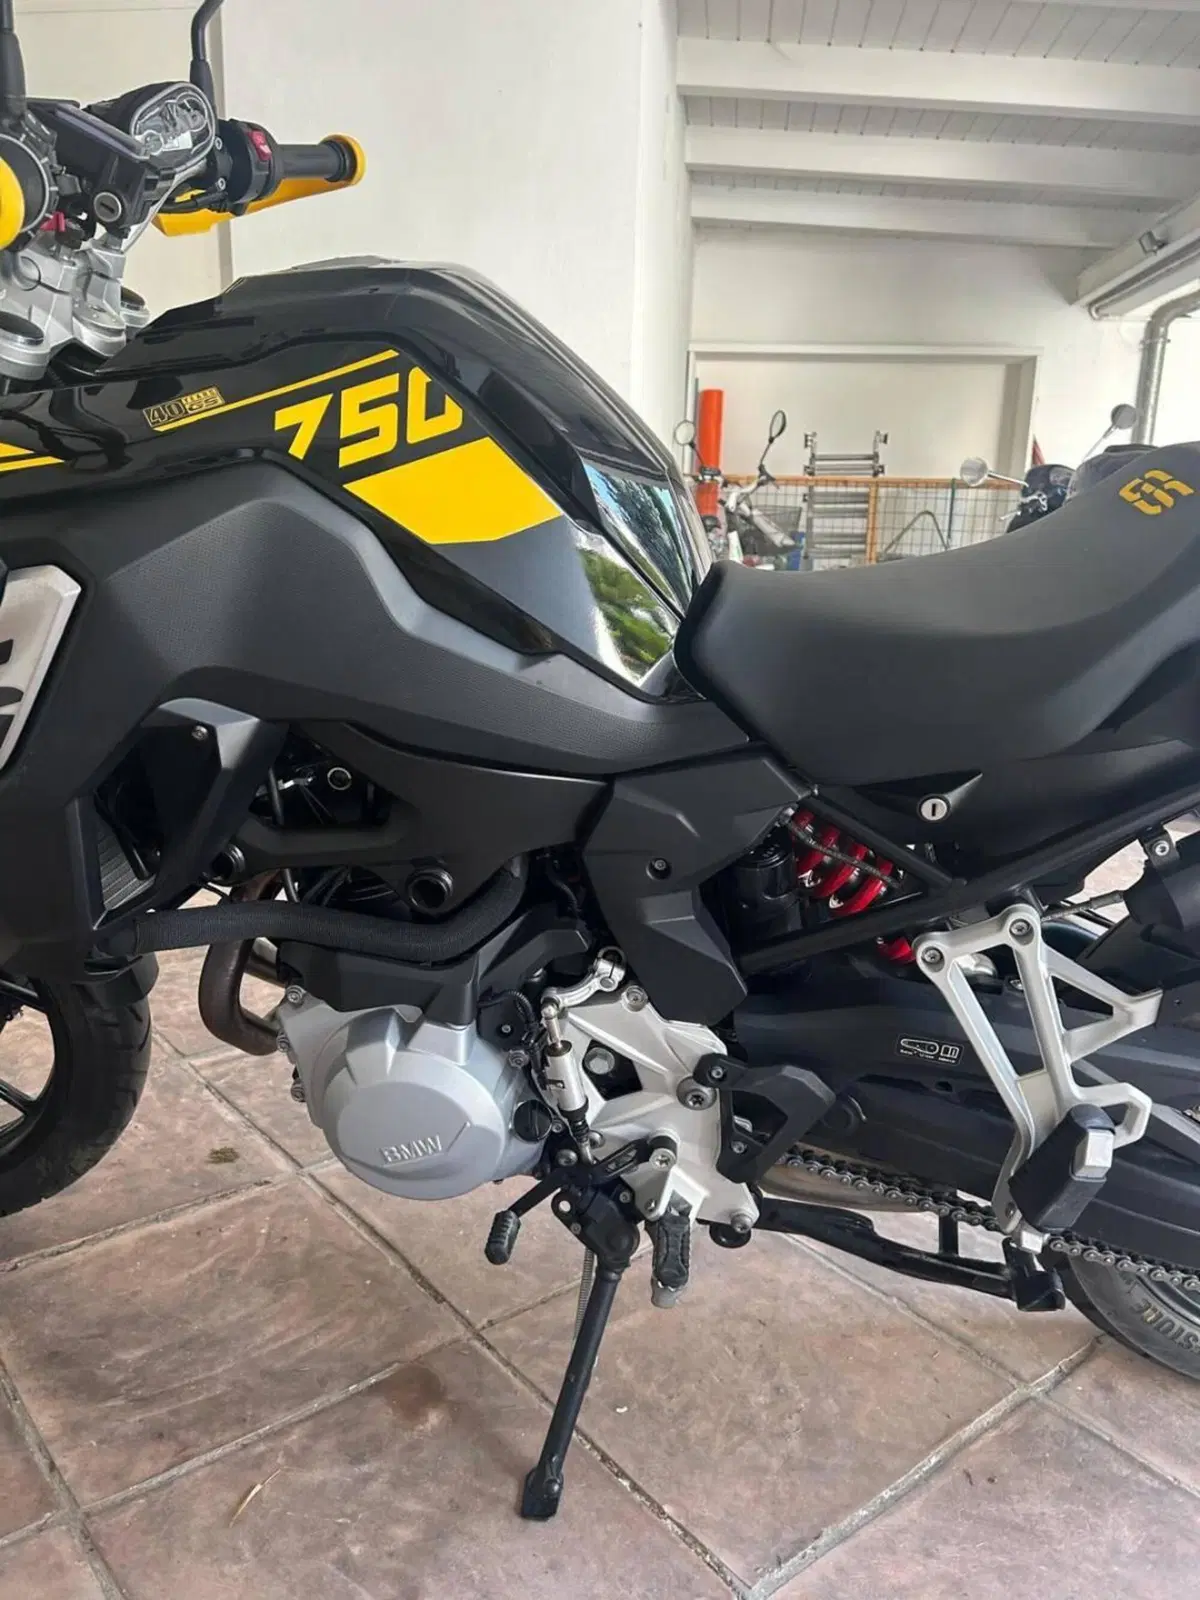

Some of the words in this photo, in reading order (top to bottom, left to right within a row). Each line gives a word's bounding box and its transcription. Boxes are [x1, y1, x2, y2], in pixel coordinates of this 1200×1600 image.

[150, 401, 185, 422] 40
[275, 367, 464, 468] 750
[380, 1134, 443, 1163] BMW
